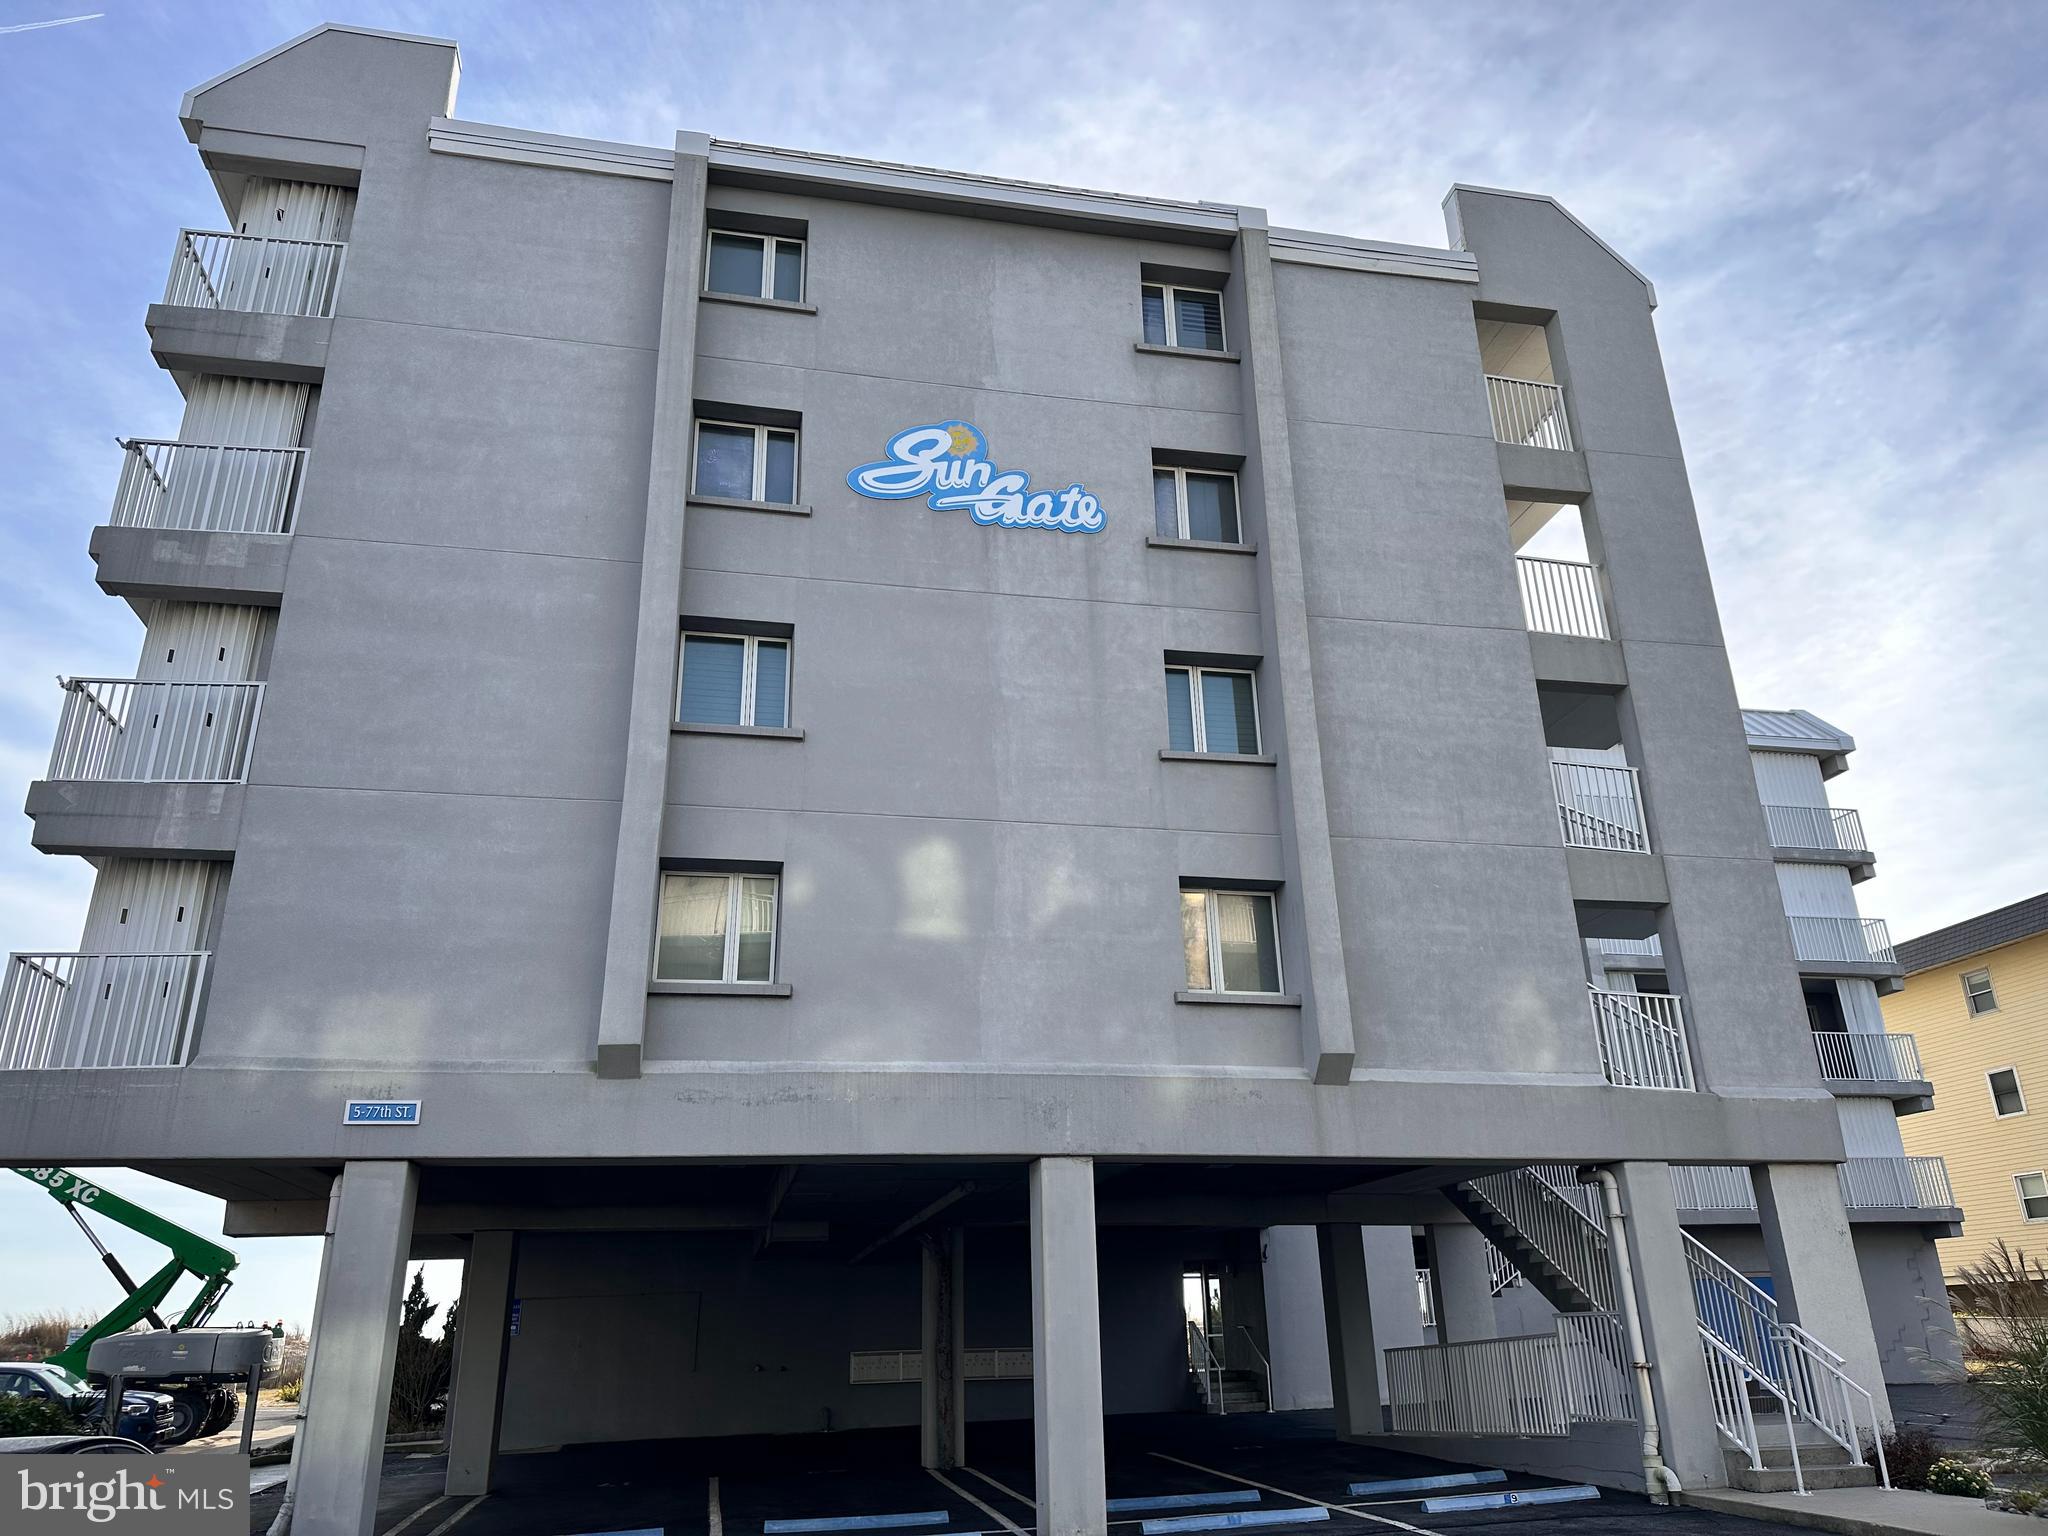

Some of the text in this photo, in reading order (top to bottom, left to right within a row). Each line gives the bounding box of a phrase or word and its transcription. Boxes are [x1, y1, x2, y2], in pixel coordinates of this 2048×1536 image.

[858, 429, 990, 493] Sun
[937, 474, 1102, 528] Gate
[353, 1105, 412, 1118] 5-77th ST.
[64, 1179, 100, 1203] XC
[1511, 1494, 1518, 1503] 9
